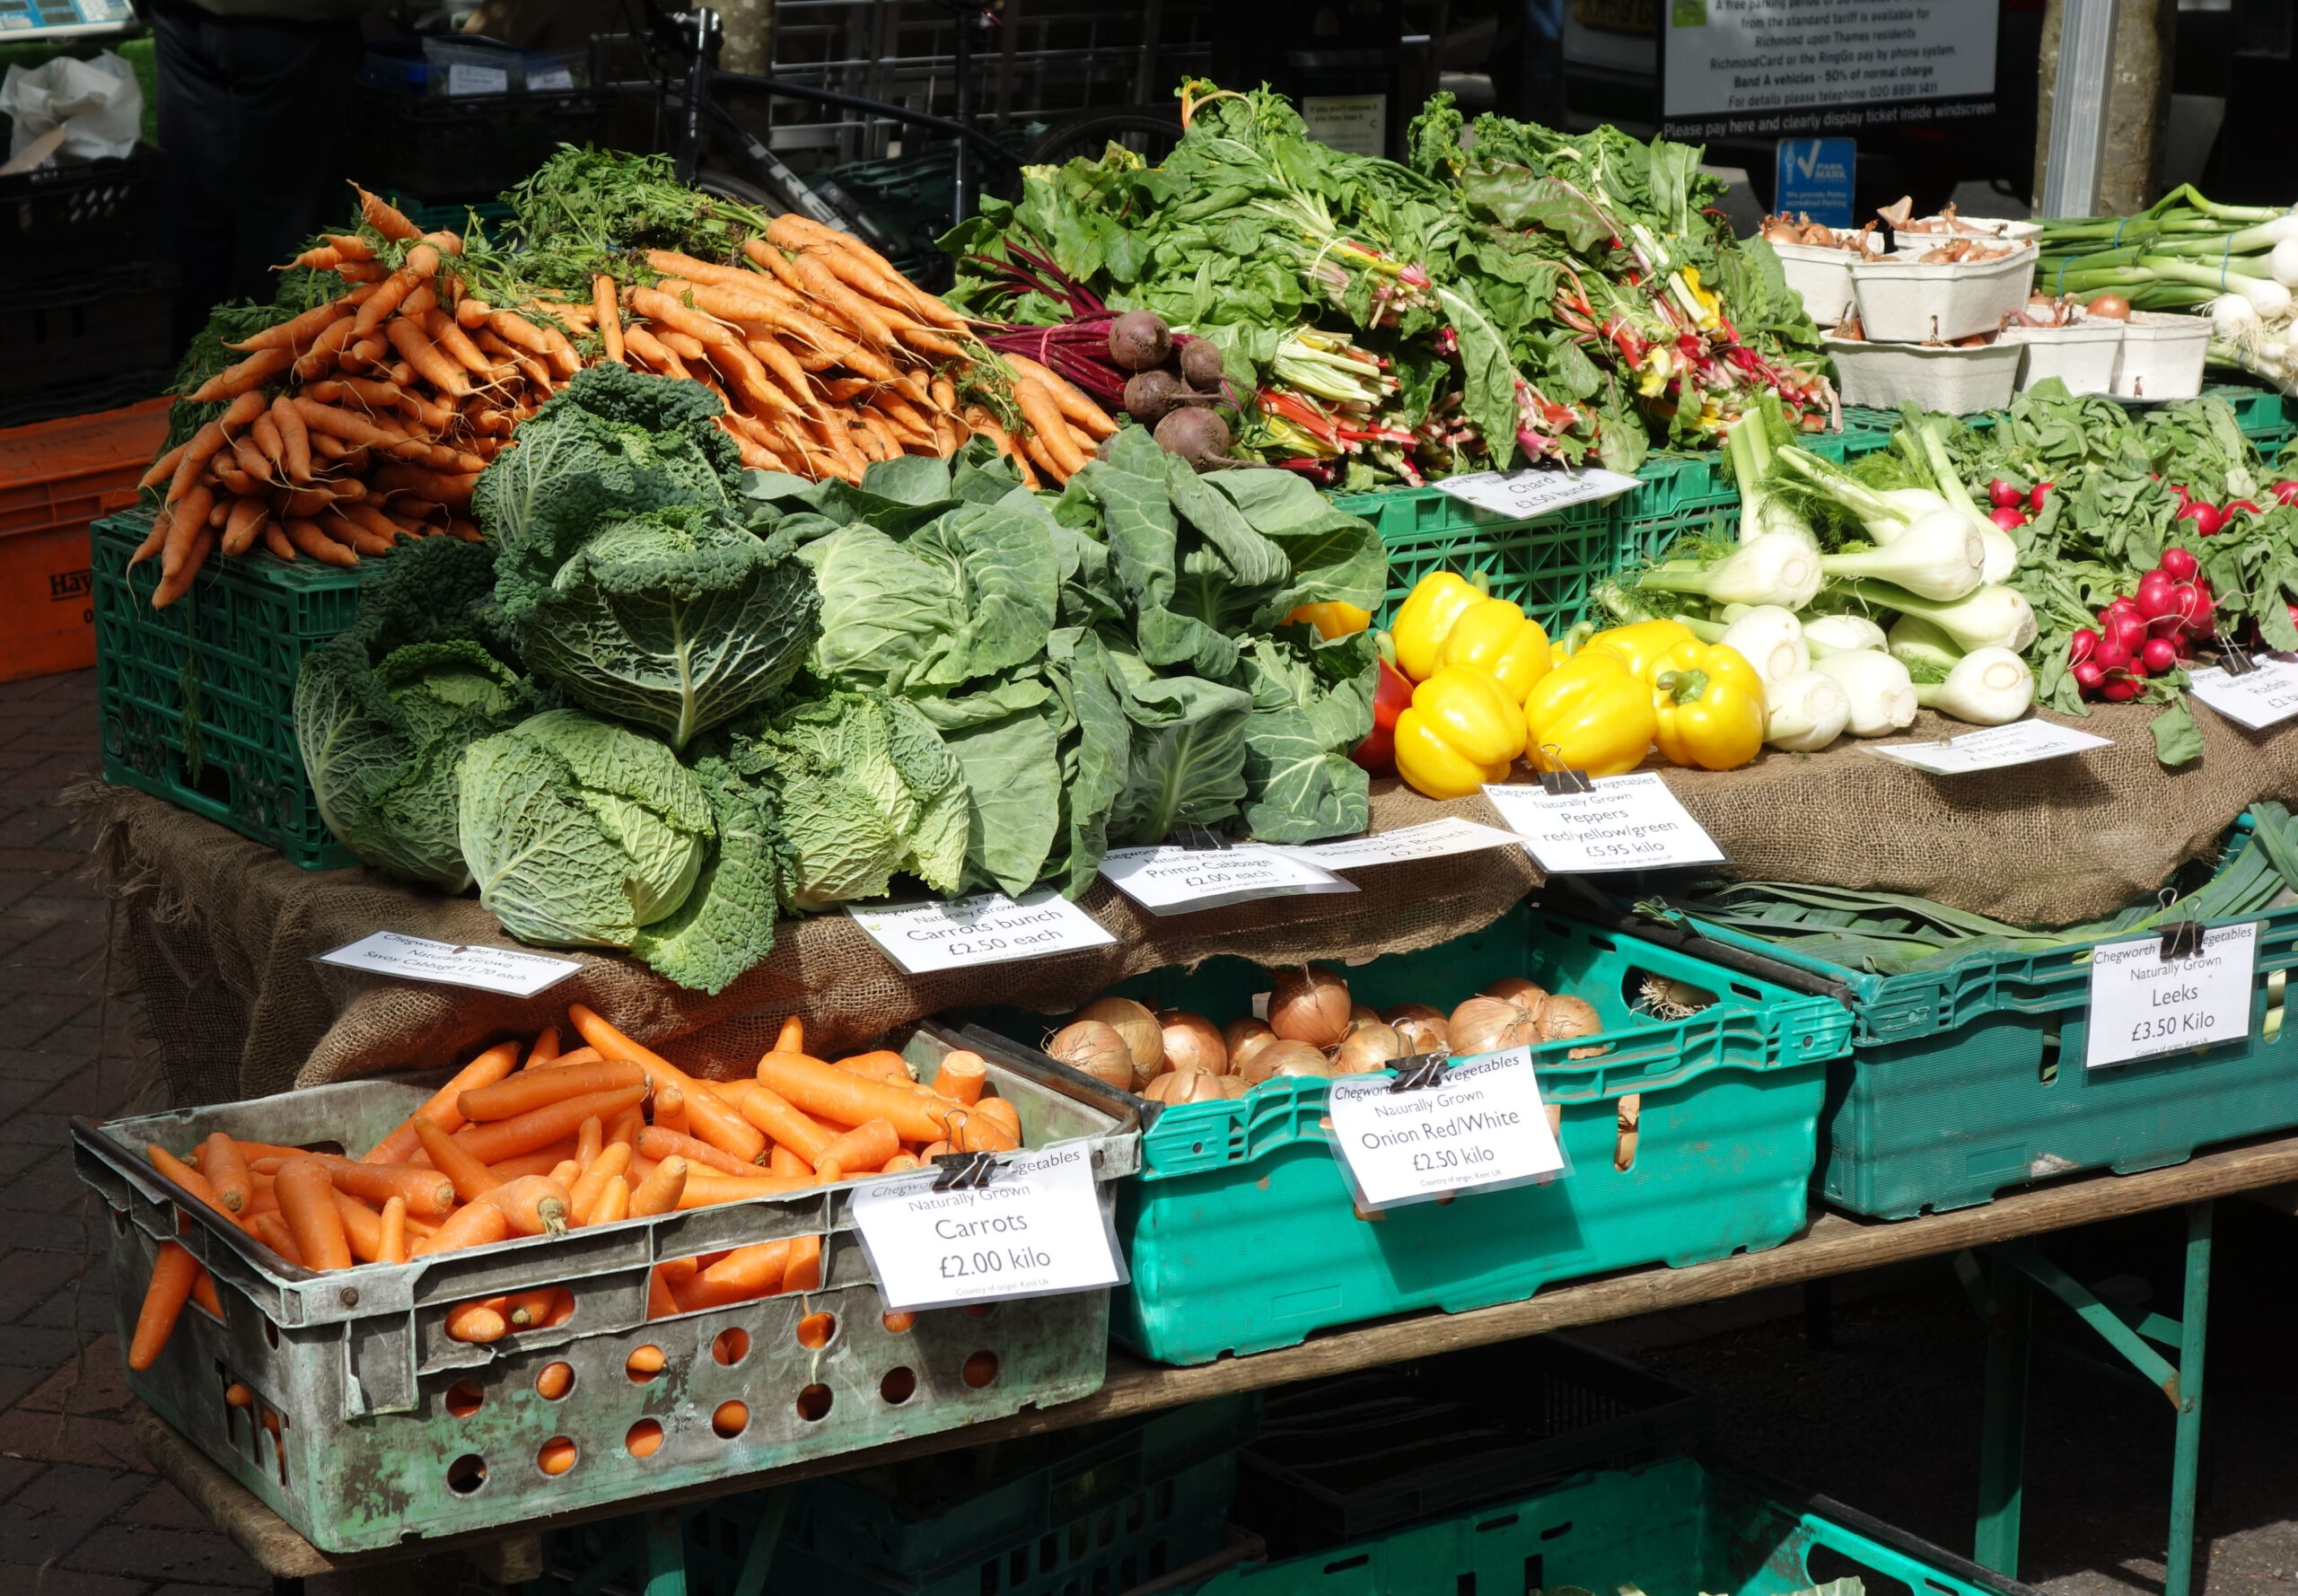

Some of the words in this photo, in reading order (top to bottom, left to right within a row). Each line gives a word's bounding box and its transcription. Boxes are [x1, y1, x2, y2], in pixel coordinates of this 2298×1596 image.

[1715, 0, 1723, 10] A
[1730, 0, 1745, 10] free
[1749, 0, 1785, 11] parking
[1741, 18, 1765, 29] from
[1768, 15, 1783, 27] the
[1786, 13, 1830, 27] standard
[1833, 11, 1857, 23] tariff
[1861, 11, 1867, 22] is
[1871, 8, 1914, 22] available
[1916, 7, 1930, 19] for
[1755, 36, 1802, 48] Richmond
[1807, 34, 1830, 47] upon
[1835, 31, 1869, 43] Thames
[1873, 28, 1916, 40] residents
[1710, 55, 1783, 71] RichmondCard
[1787, 55, 1796, 66] or
[1800, 52, 1815, 65] the
[1819, 50, 1854, 66] RingGo
[1857, 50, 1873, 62] pay
[1877, 48, 1887, 61] by
[1890, 47, 1919, 59] phone
[1734, 75, 1759, 88] Band
[1764, 75, 1771, 86] A
[1775, 72, 1814, 85] vehicles
[1825, 70, 1847, 83] 50%
[1851, 68, 1861, 81] of
[1864, 66, 1897, 79] normal
[1900, 65, 1934, 78] charge
[1729, 95, 1744, 107] For
[1748, 92, 1781, 106] details
[1785, 92, 1815, 105] please
[1820, 88, 1866, 102] telephone
[1870, 84, 1890, 99] 020
[1664, 122, 1702, 137] Please
[1706, 123, 1726, 137] pay
[1730, 118, 1755, 132] here
[1759, 116, 1781, 130] and
[1783, 112, 1821, 130] clearly
[1823, 110, 1864, 127] display
[1867, 107, 1897, 123] ticket
[1900, 105, 1932, 121] inside
[1934, 101, 1995, 118] windscreen
[743, 131, 857, 235] TRE
[1814, 171, 1846, 179] MARK
[1509, 477, 1557, 494] Chard
[1514, 494, 1557, 509] £2.50
[1553, 481, 1599, 497] bunch
[1488, 787, 1547, 798] Chegwort
[1592, 776, 1656, 791] Vegetables
[1532, 797, 1587, 809] Naturally
[1589, 792, 1633, 805] Grown
[1560, 808, 1628, 825] Peppers
[1408, 829, 1472, 845] Bunch
[1541, 820, 1679, 844] red/yellow/green
[1144, 853, 1200, 864] Naturally
[1202, 850, 1245, 860] Grown
[1585, 844, 1630, 857] £5.95
[1631, 840, 1665, 854] kilo
[1145, 865, 1199, 879] Primo
[1203, 858, 1274, 871] Cabbage
[1186, 871, 1231, 887] £2.00
[1235, 869, 1275, 880] each
[907, 921, 994, 942] Carrots
[995, 909, 1064, 930] bunch
[913, 908, 975, 925] Naturally
[976, 902, 1024, 916] Grown
[382, 933, 453, 953] Chegworth
[495, 950, 564, 968] Vegetables
[948, 937, 1007, 957] £2.50
[1013, 928, 1064, 945] each
[2093, 943, 2156, 965] Chegworth
[2202, 925, 2252, 947] egetables
[363, 951, 402, 964] Savoy
[403, 958, 456, 972] Cabbage
[458, 964, 497, 977] £1.70
[496, 970, 528, 982] each
[408, 949, 463, 963] Naturally
[468, 955, 513, 969] Grown
[2130, 959, 2180, 982] Naturally
[2182, 955, 2222, 971] Grown
[2152, 984, 2198, 1007] Leeks
[2131, 1016, 2177, 1042] £3.50
[2182, 1011, 2215, 1033] Kilo
[1335, 1086, 1391, 1102] Chegwort
[1444, 1056, 1520, 1083] Vegetables
[1374, 1098, 1434, 1118] Naturally
[1437, 1088, 1485, 1109] Grown
[1362, 1128, 1420, 1150] Onion
[1422, 1110, 1521, 1140] Red/White
[1011, 1151, 1081, 1176] getables
[1413, 1150, 1459, 1172] £2.50
[1461, 1144, 1495, 1166] kilo
[908, 1190, 975, 1213] Naturally
[979, 1185, 1031, 1202] Grown
[935, 1214, 1028, 1240] Carrots
[939, 1250, 1004, 1278] £2.00
[1008, 1247, 1051, 1270] kilo
